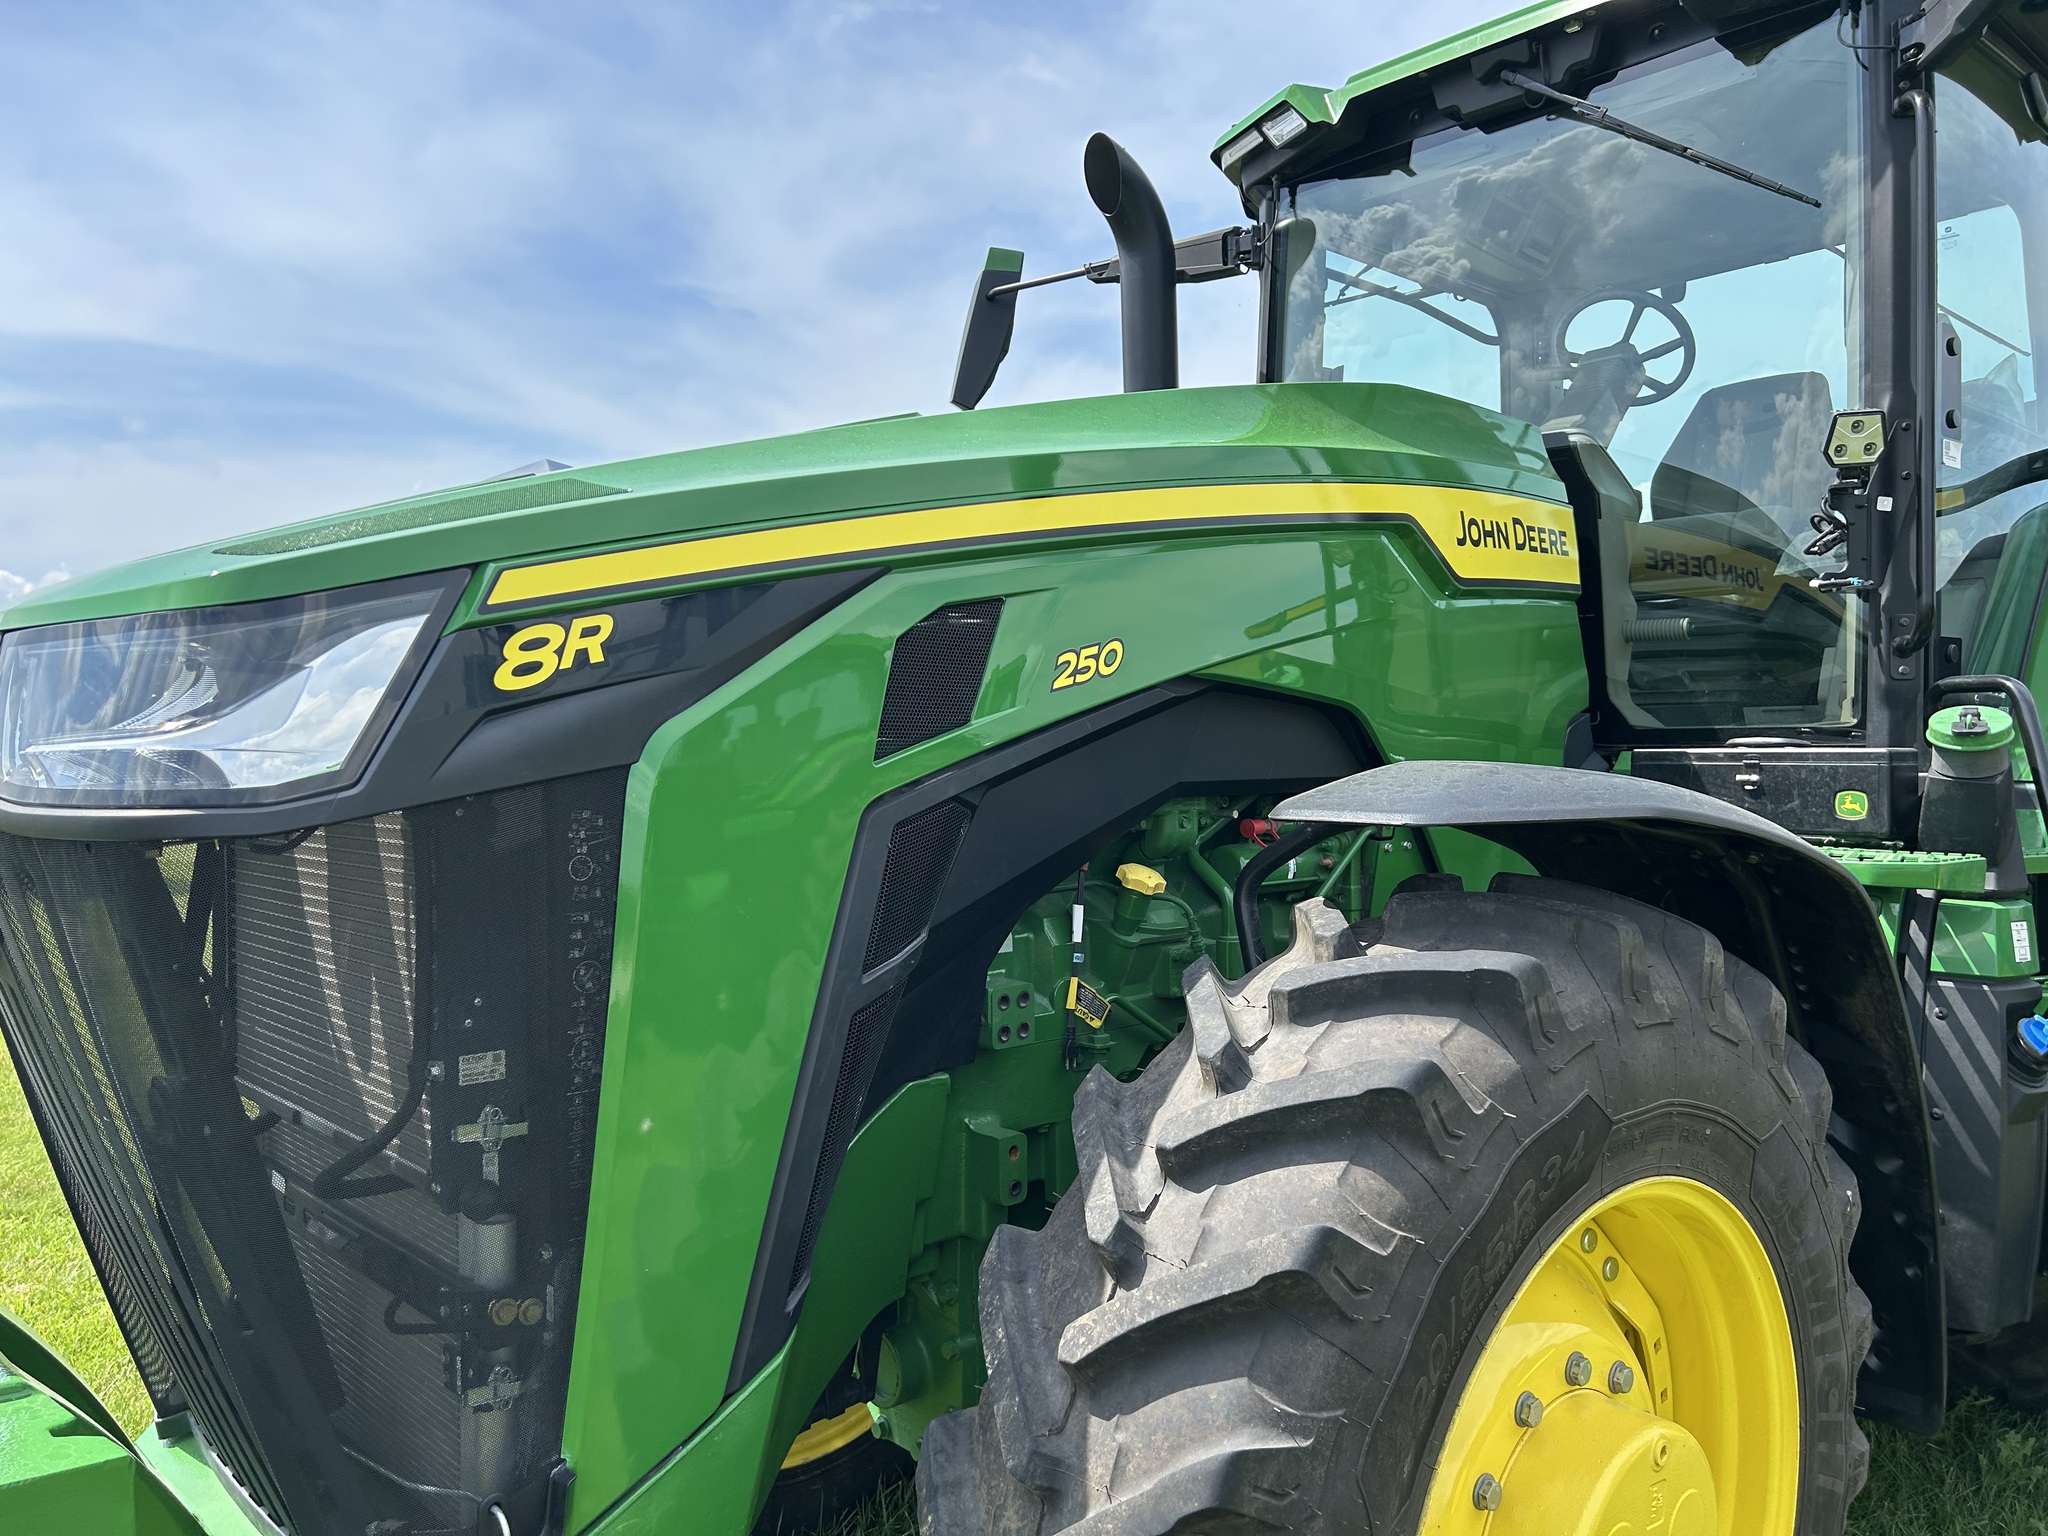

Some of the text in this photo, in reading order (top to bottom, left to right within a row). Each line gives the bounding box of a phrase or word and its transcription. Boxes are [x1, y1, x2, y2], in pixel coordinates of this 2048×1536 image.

[1456, 510, 1569, 557] JOHN DEERE
[493, 613, 614, 691] 8R
[1051, 638, 1124, 691] 250
